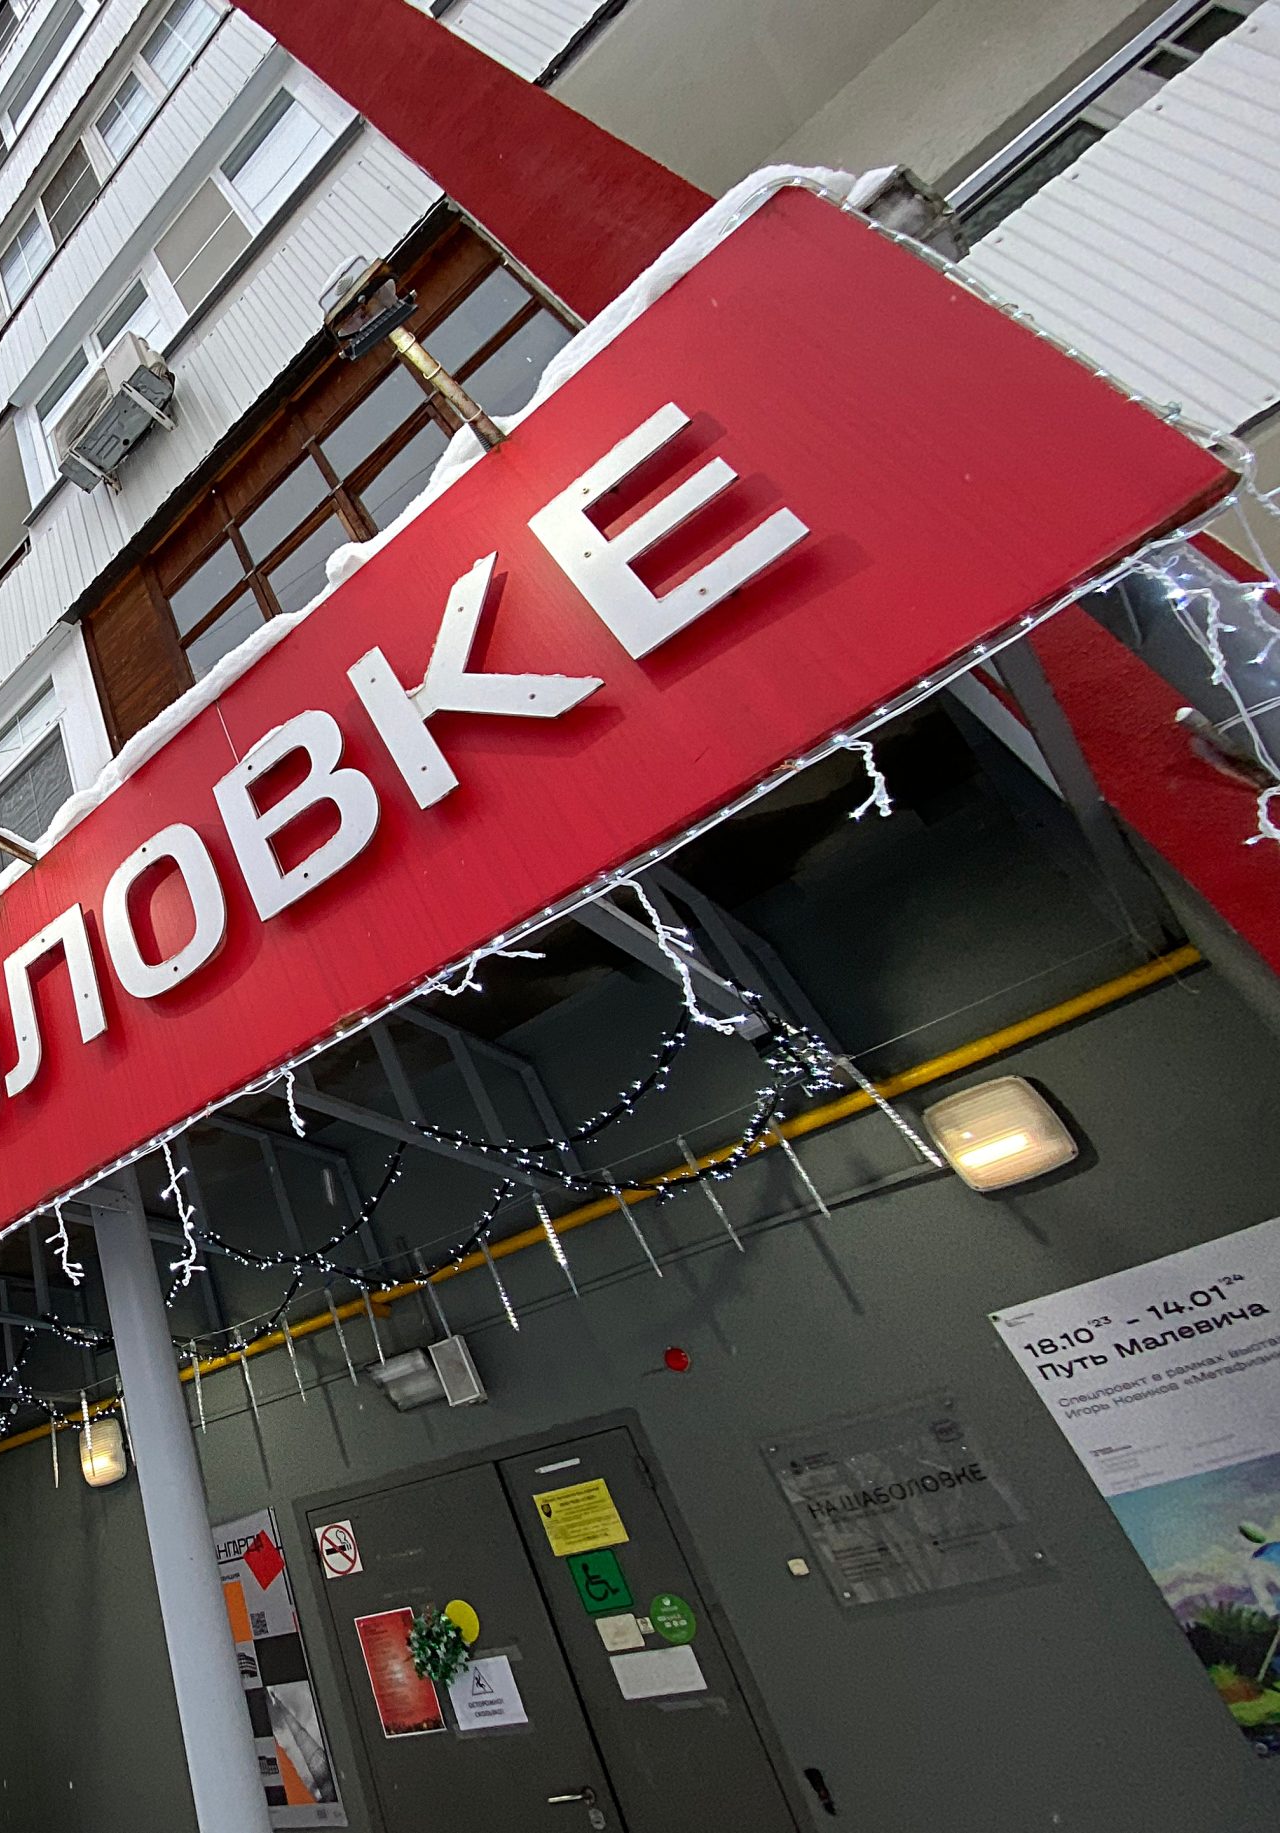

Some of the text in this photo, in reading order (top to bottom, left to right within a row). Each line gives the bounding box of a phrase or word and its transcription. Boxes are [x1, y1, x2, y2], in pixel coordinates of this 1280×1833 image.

[1037, 1302, 1271, 1380] Путь Малевича
[1058, 1333, 1280, 1408] Спецпроект в рамках выста
[1064, 1401, 1110, 1420] Игорь
[1114, 1382, 1180, 1408] Новиков
